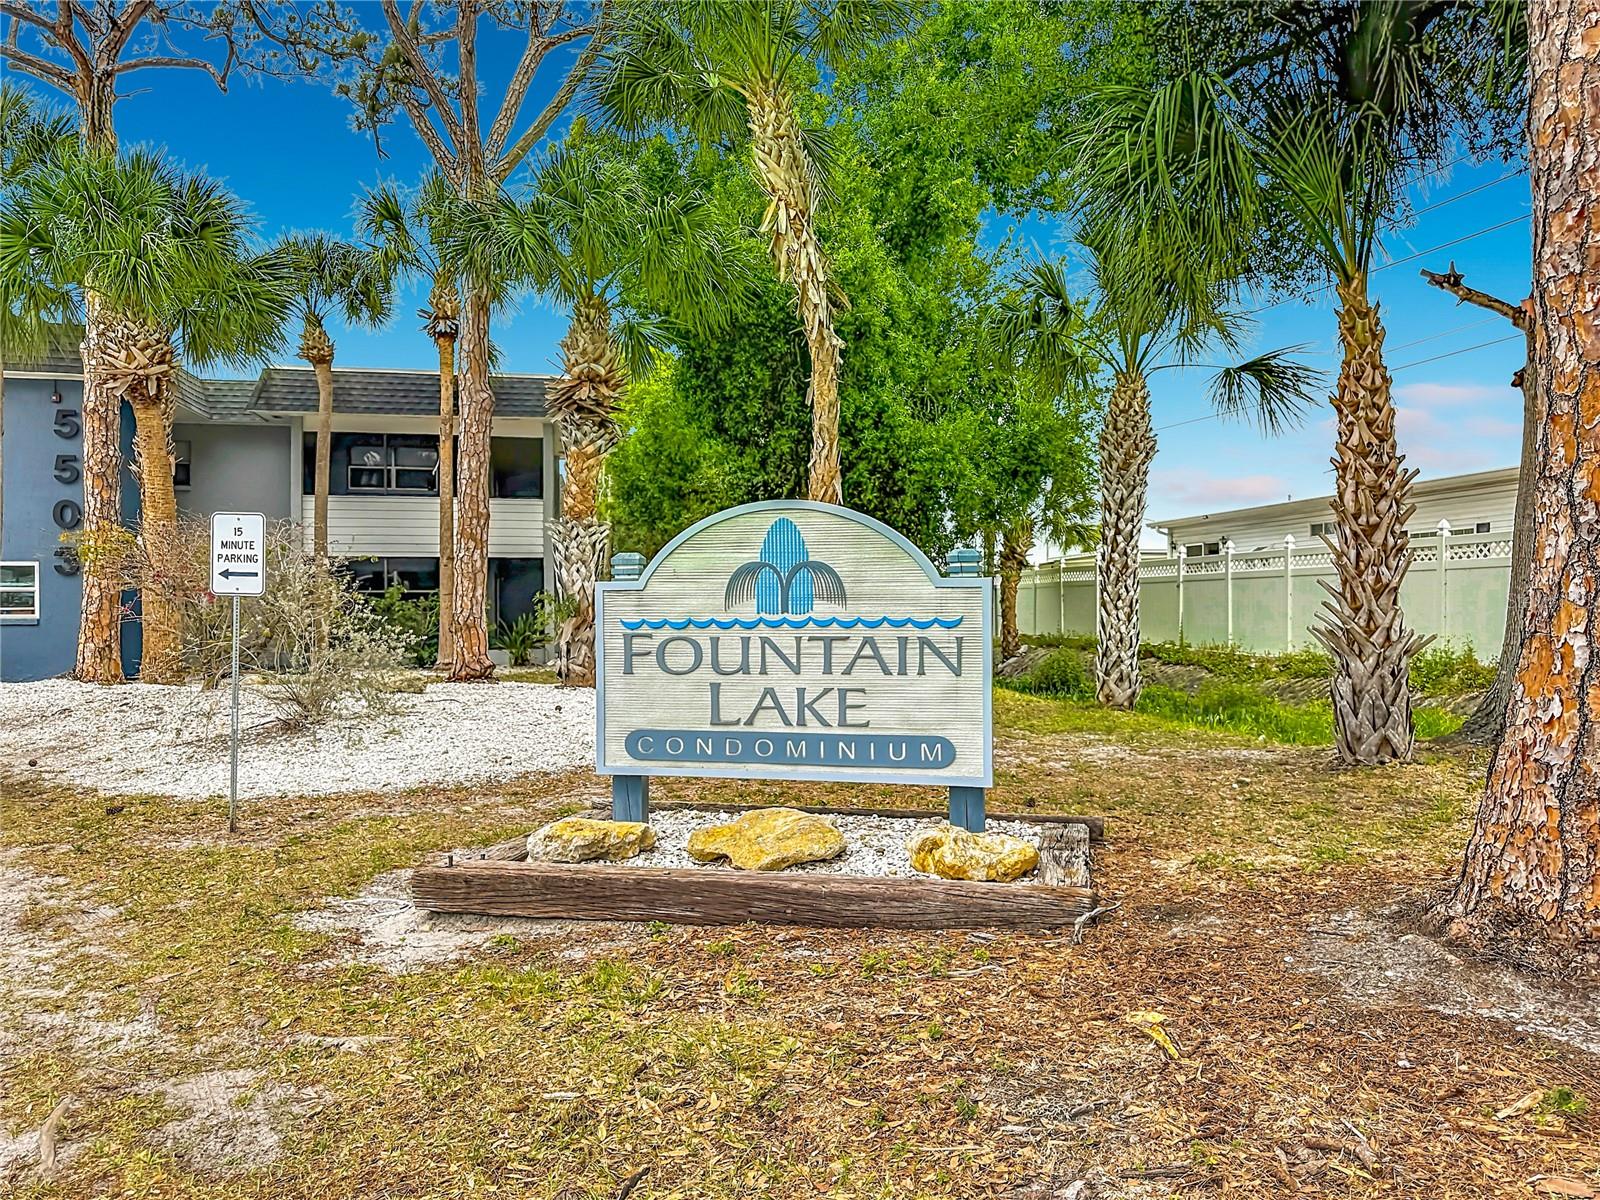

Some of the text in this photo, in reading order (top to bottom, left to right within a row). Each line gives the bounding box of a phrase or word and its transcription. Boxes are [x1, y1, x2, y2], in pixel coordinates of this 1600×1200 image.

[233, 527, 243, 537] 15
[220, 540, 255, 550] MINUTE
[217, 553, 259, 564] PARKING
[622, 633, 964, 677] FOUNTAIN
[709, 682, 871, 728] LAKE
[637, 736, 943, 762] CONDOMINIUM
